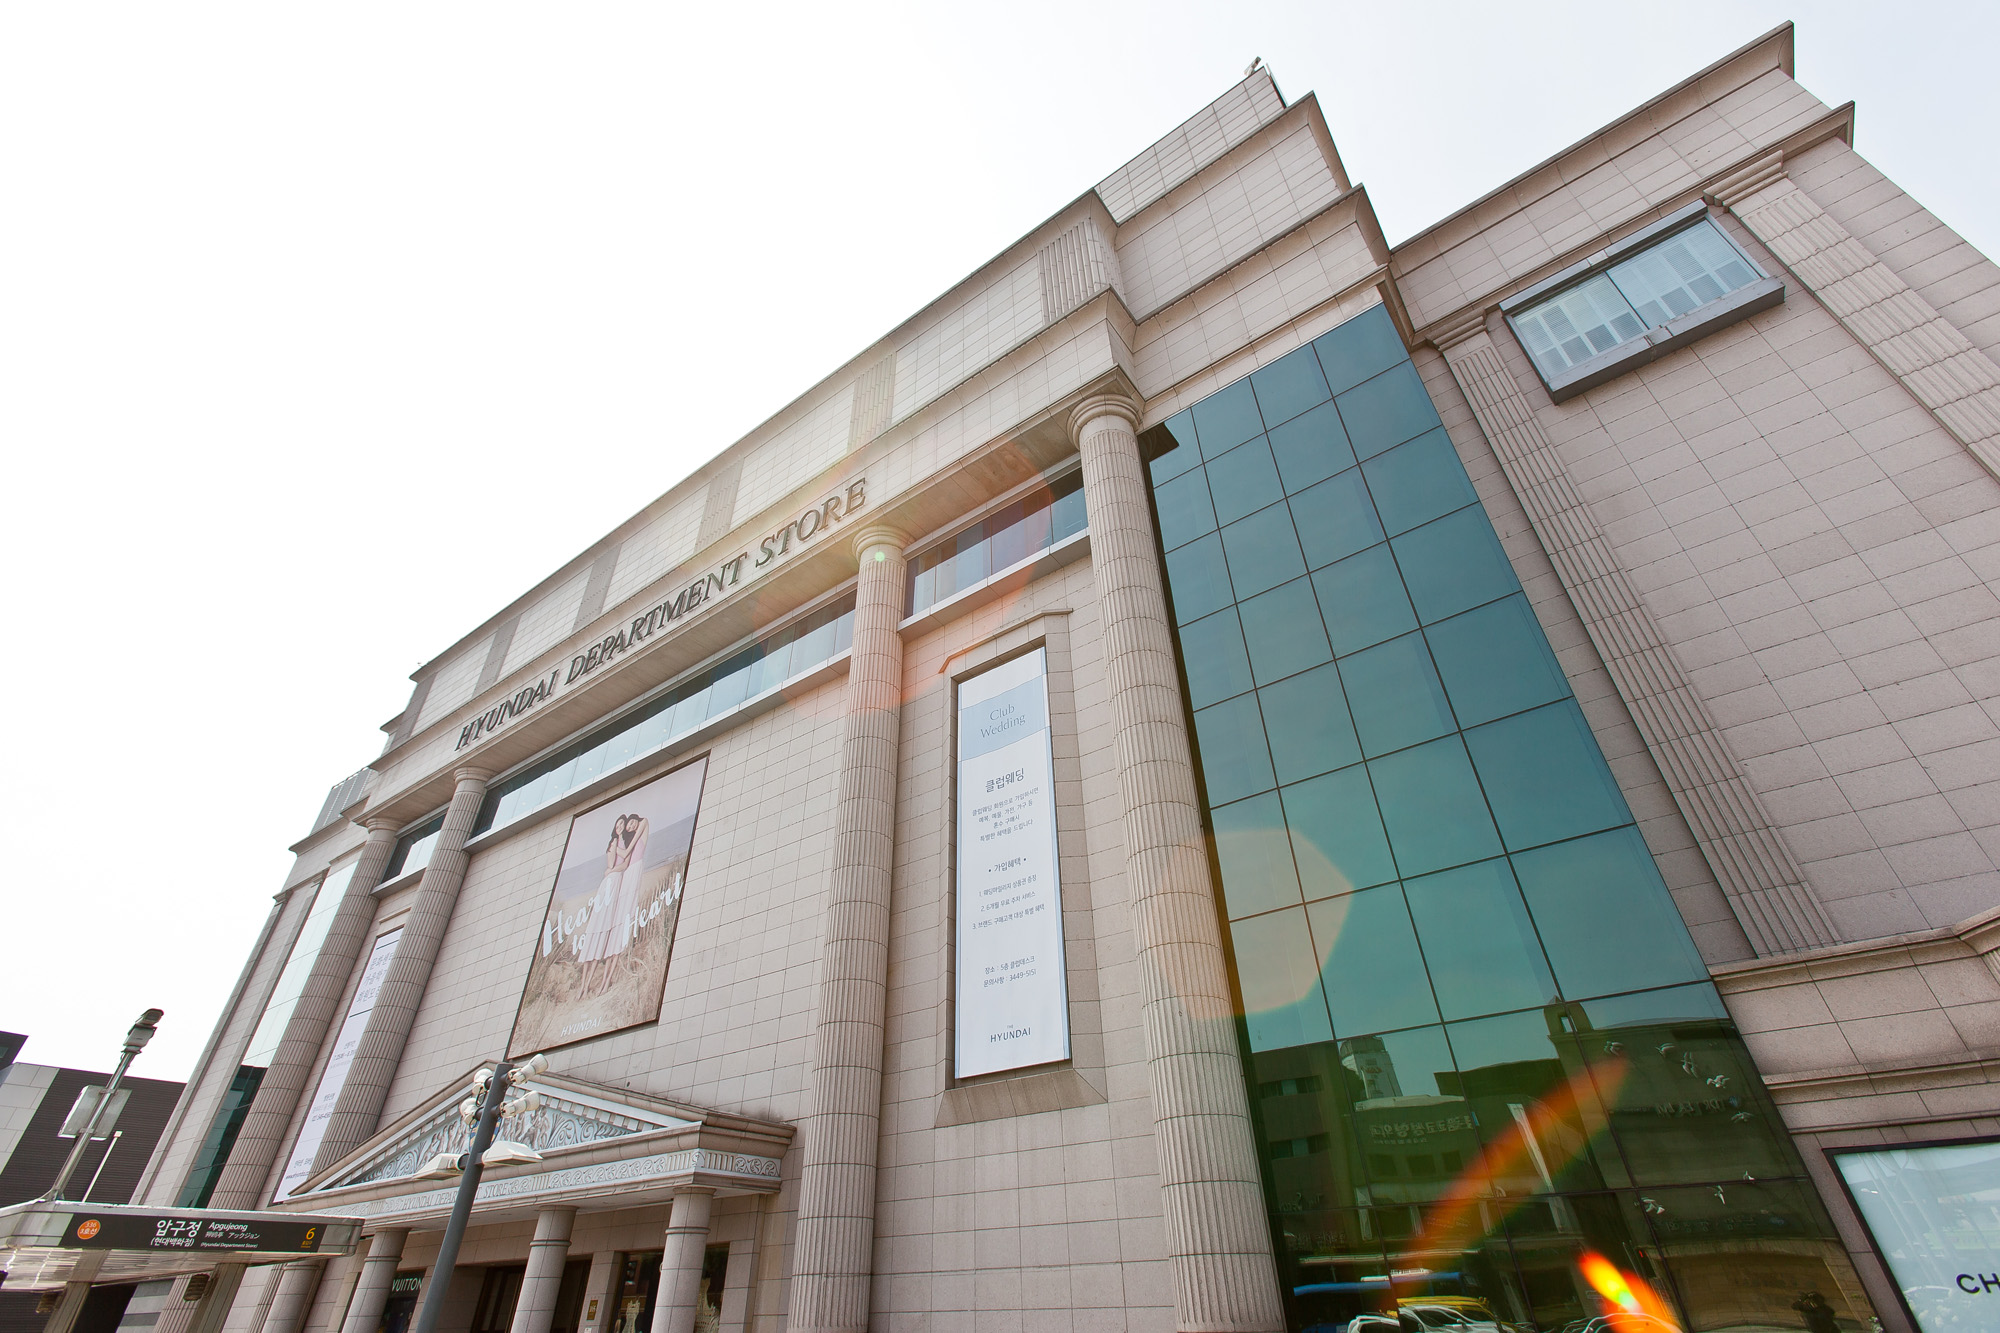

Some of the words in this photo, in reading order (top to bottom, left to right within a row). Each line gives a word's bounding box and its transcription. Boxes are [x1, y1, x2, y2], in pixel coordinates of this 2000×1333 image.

[454, 669, 560, 751] HYUNDAI
[564, 552, 748, 686] DEPARTMENT
[755, 477, 867, 568] STORE
[989, 703, 1015, 721] Club
[980, 713, 1026, 738] Wedding
[985, 767, 1025, 793] 클럽웨딩
[1013, 819, 1033, 831] 드립니다
[993, 857, 1022, 872] 가입혜택
[1000, 899, 1010, 907] 무료
[1011, 896, 1021, 904] 주차
[1021, 891, 1036, 901] 서비스
[542, 877, 614, 957] Heart
[572, 933, 587, 955] to
[621, 872, 685, 947] Heart
[978, 919, 993, 928] 브랜드
[1009, 955, 1036, 969] 클럽데스크
[983, 976, 1005, 988] 문의사항
[560, 1015, 603, 1038] HYUNDAI
[990, 1027, 1031, 1043] HYUNDAI
[402, 1195, 434, 1210] HYUNDAI
[484, 1182, 508, 1199] STORE
[79, 1227, 98, 1235] 3호선
[155, 1219, 203, 1238] 압구정
[208, 1221, 249, 1232] Apgujeong
[306, 1227, 316, 1240] 6
[150, 1236, 195, 1247] (현대백화점)
[392, 1277, 424, 1292] VUITTON
